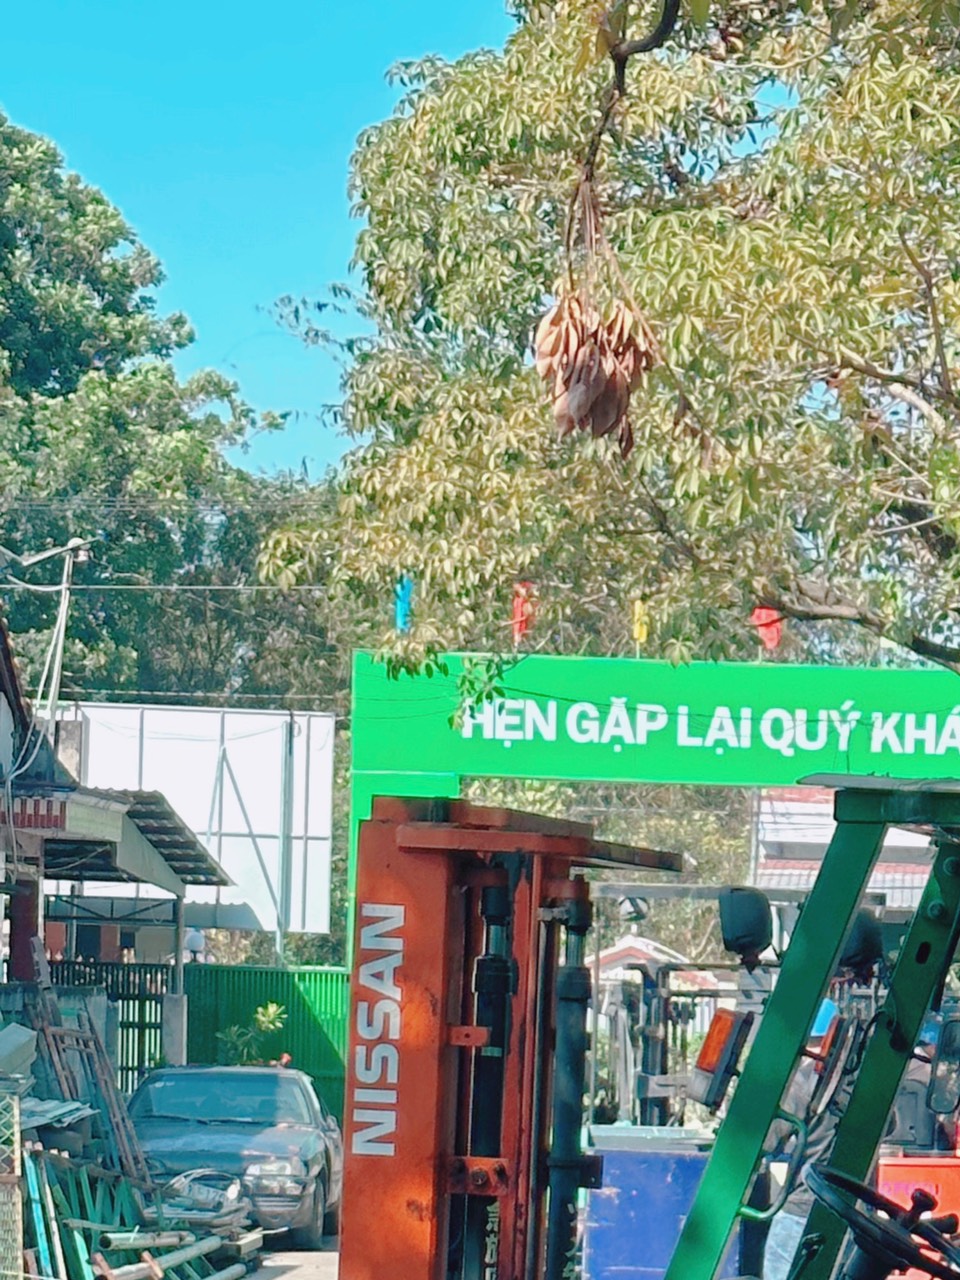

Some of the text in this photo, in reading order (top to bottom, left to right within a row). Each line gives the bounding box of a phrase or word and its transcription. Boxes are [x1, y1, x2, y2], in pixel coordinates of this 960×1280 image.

[461, 697, 558, 749] HẸN
[565, 696, 669, 754] GẶP
[676, 705, 752, 756] LẠI
[760, 700, 859, 758] QUÝ
[351, 902, 406, 1157] NISSAN
